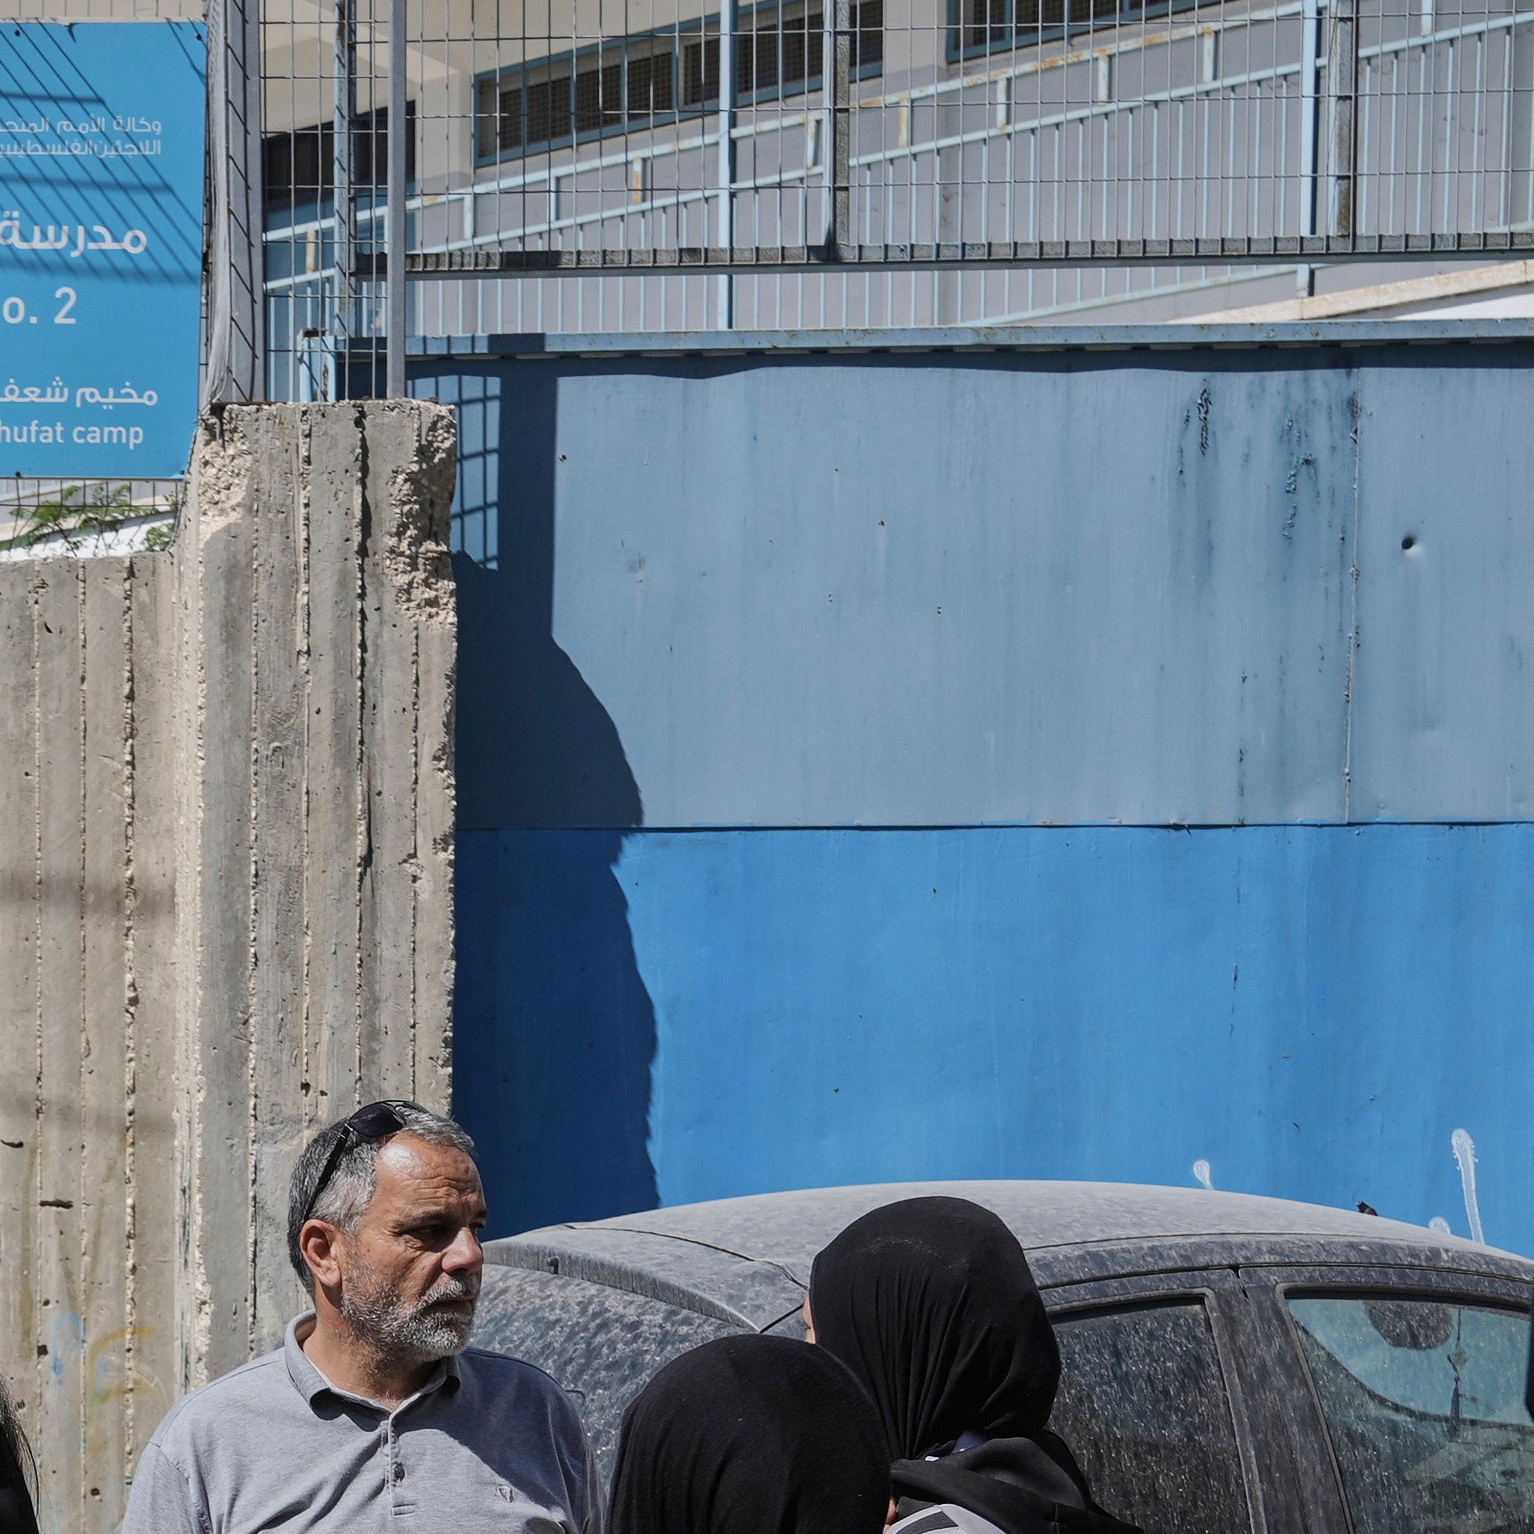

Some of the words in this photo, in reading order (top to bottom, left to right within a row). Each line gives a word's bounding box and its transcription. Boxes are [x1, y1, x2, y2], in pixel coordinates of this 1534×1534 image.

[54, 287, 77, 324] 2
[75, 381, 158, 409] مخيم
[72, 424, 144, 449] camp
